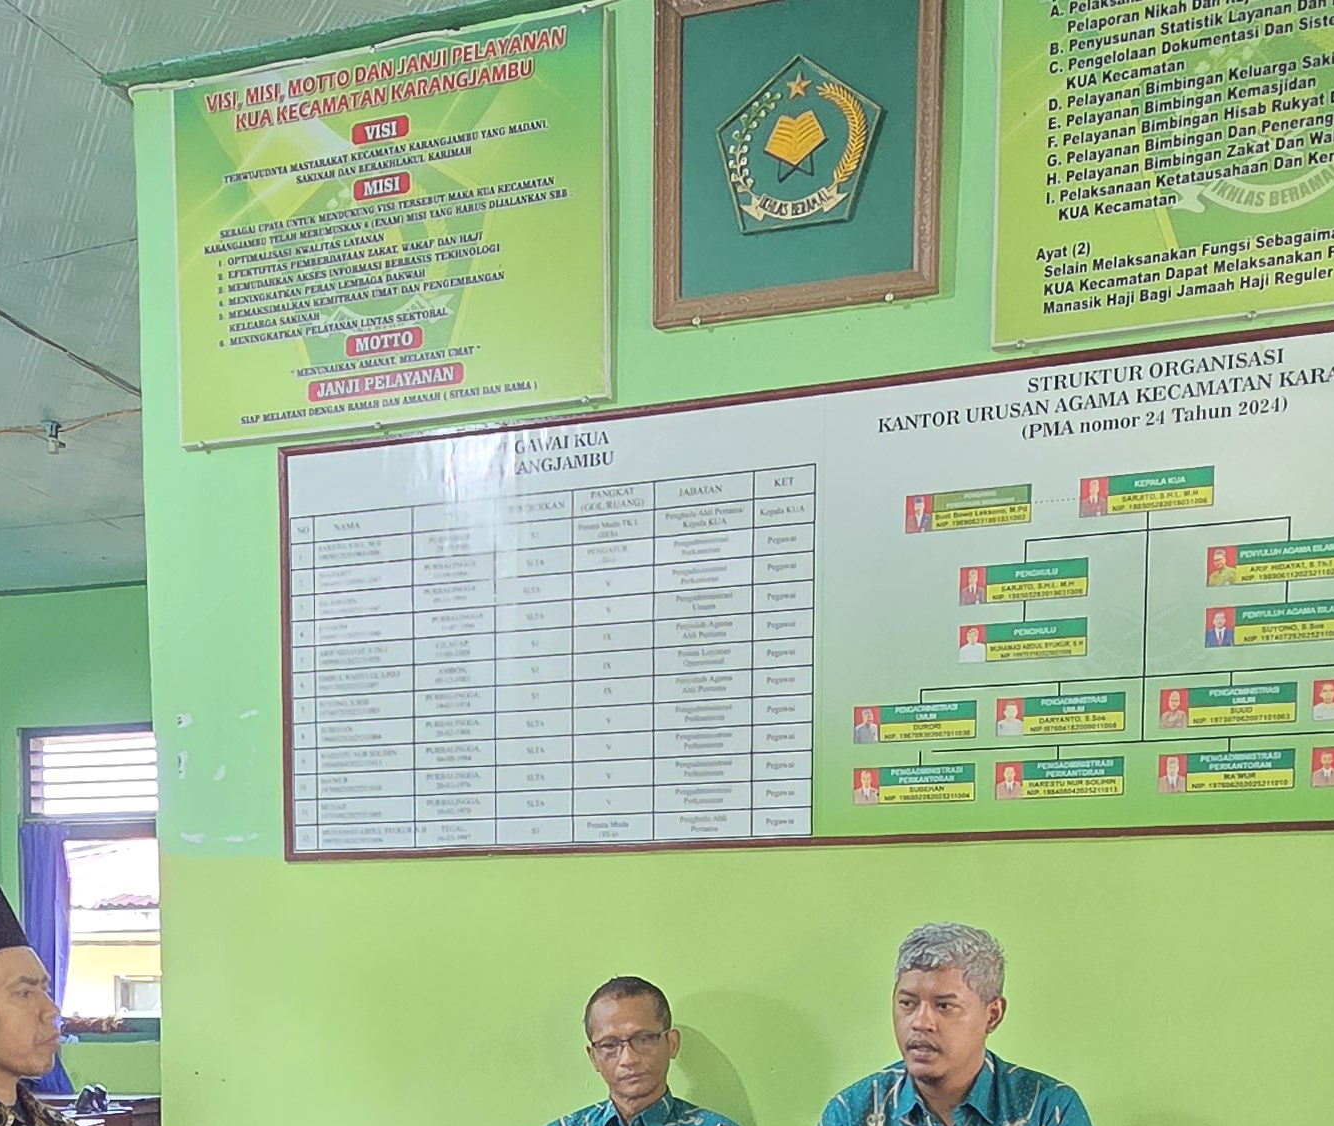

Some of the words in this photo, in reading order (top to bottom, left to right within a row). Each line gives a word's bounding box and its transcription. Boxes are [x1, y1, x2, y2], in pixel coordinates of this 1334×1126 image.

[205, 87, 243, 114] VISI,
[245, 80, 285, 107] MISI,
[287, 67, 351, 99] MOTTO
[353, 58, 394, 86] DAN
[395, 47, 449, 78] JANJI
[451, 23, 567, 67] PELAYANAN
[1048, 98, 1062, 111] D.
[1067, 83, 1141, 108] Pelayanan
[1145, 73, 1226, 98] Bimbingan
[1228, 61, 1296, 81] Keluarga
[234, 107, 273, 133] KUA
[276, 85, 388, 126] KECAMATAN
[389, 56, 533, 104] KARANGJAMBU
[364, 120, 397, 140] VISI
[1047, 135, 1058, 149] F.
[1062, 125, 1136, 146] Pelayanan
[1141, 109, 1218, 137] Bimbingan
[1223, 101, 1266, 123] Hisab
[1271, 93, 1324, 113] Rukyat
[1046, 153, 1061, 167] G.
[1066, 144, 1139, 164] Pelayanan
[1145, 131, 1222, 154] Bimbingan
[1228, 125, 1259, 140] Dan
[363, 175, 400, 196] MISI
[1212, 179, 1266, 206] IKHLAS
[1035, 245, 1067, 263] Ayat
[1072, 241, 1090, 258] (2)
[1043, 261, 1087, 278] Selain
[1092, 245, 1196, 271] Melaksanakan
[1201, 237, 1250, 256] Fungsi
[1043, 280, 1074, 296] KUA
[1079, 272, 1160, 291] Kecamatan
[1165, 263, 1208, 281] Dapat
[1213, 250, 1322, 274] Melaksanakan
[1043, 295, 1102, 314] Manasik
[1106, 290, 1134, 307] Haji
[1139, 285, 1171, 303] Bagi
[1176, 278, 1235, 297] Jamaah
[1240, 273, 1269, 290] Haji
[1274, 266, 1333, 285] Reguler
[355, 330, 413, 352] MOTTO
[316, 378, 360, 397] JANJI
[364, 365, 454, 391] PELAYANAN
[1027, 365, 1142, 393] STRUKTUR
[1149, 348, 1283, 378] ORGANISASI
[878, 410, 960, 433] KANTOR
[966, 399, 1049, 423] URUSAN
[1054, 390, 1129, 413] AGAMA
[1136, 373, 1272, 404] KECAMATAN
[1021, 420, 1074, 439] (PMA
[1080, 416, 1141, 433] nomor
[1145, 410, 1164, 426] 24
[1171, 404, 1231, 423] Tahun
[1238, 397, 1288, 416] 2024)
[508, 434, 569, 456] GAWAI
[573, 429, 609, 448] KUA
[515, 449, 614, 476] ANGJAMBU
[678, 483, 722, 498] JABATAN
[773, 476, 794, 489] KET
